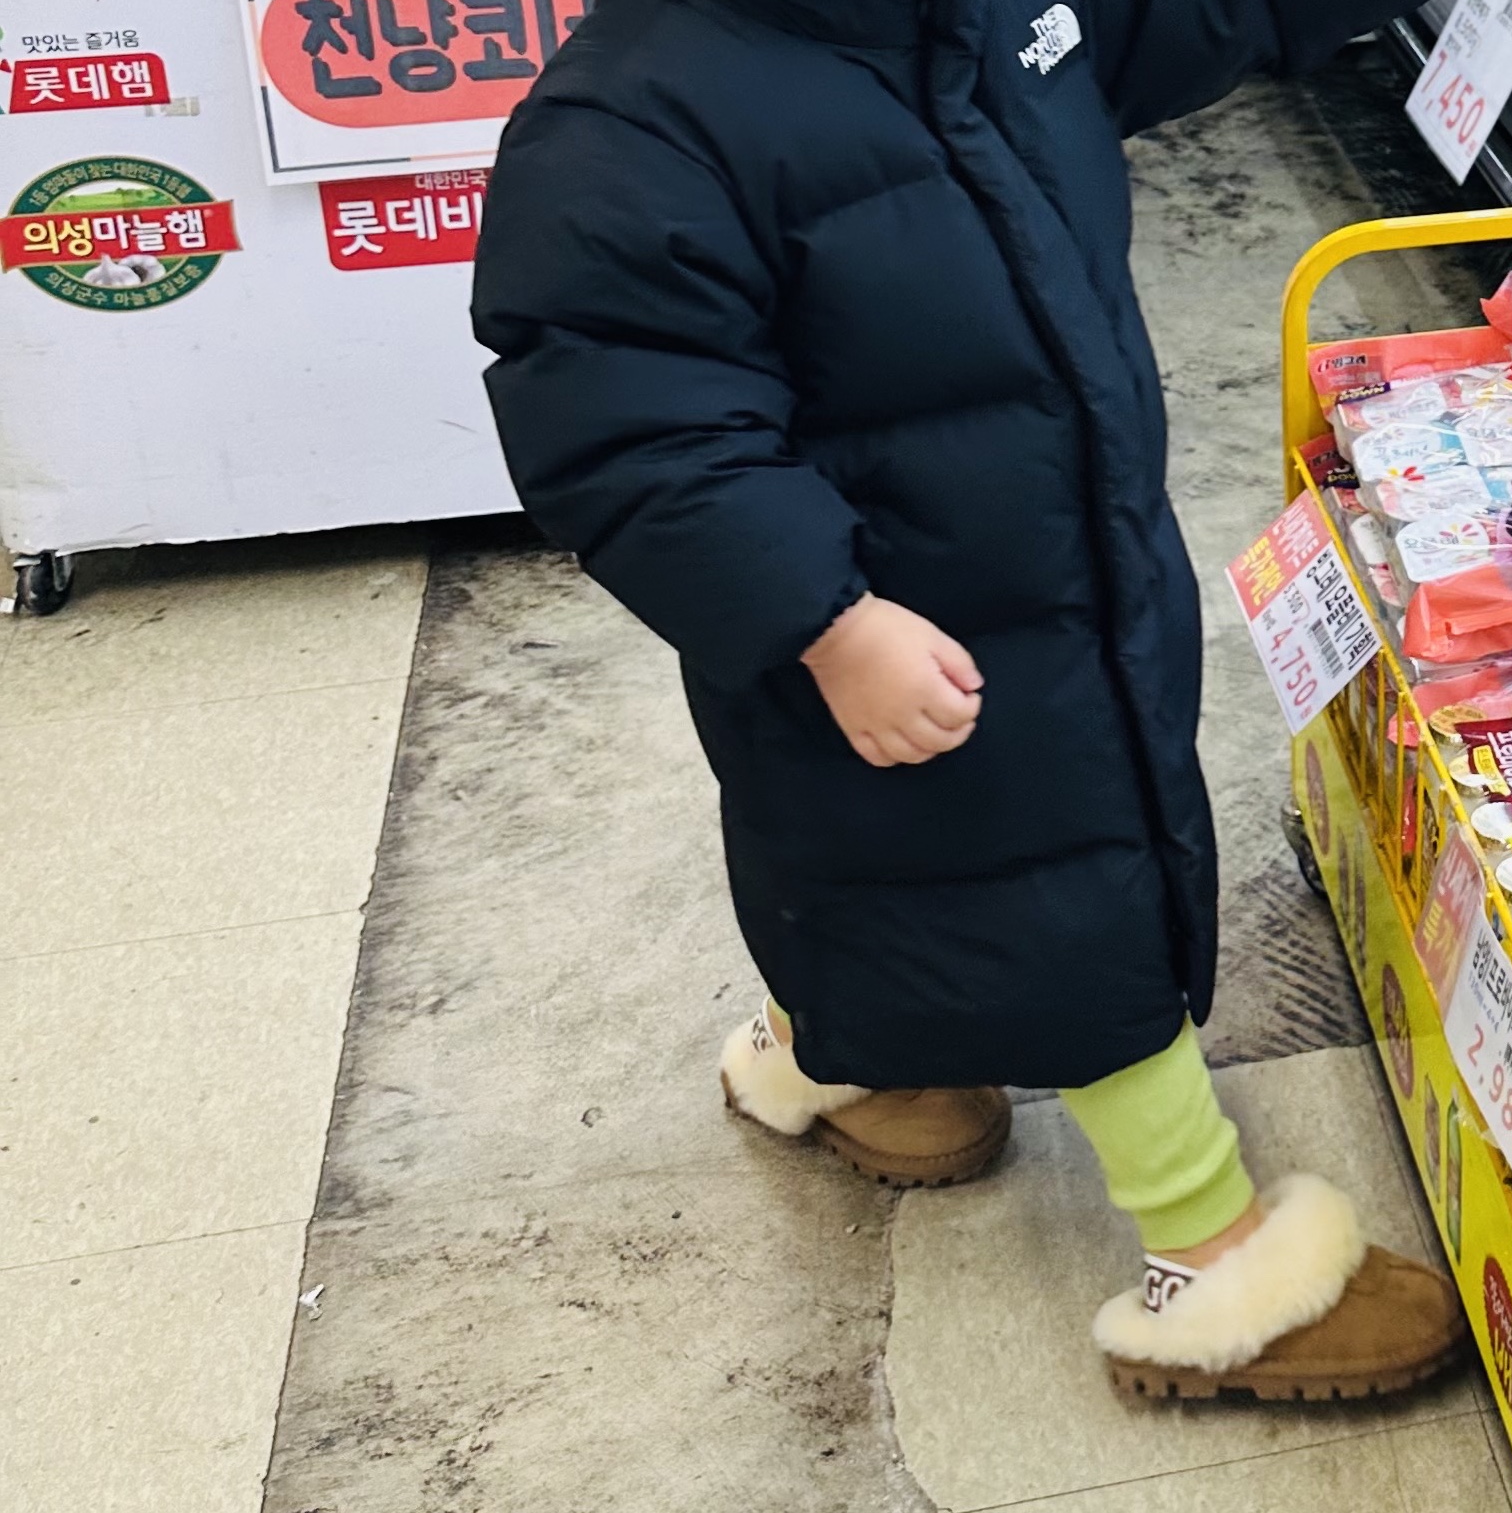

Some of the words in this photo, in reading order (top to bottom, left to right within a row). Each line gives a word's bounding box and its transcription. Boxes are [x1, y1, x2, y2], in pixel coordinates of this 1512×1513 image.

[22, 33, 79, 52] 맛있는
[85, 29, 139, 50] 즐거움
[24, 60, 153, 106] 롯데햄
[23, 209, 206, 256] 의성마늘햄
[334, 193, 484, 256] 롯데비
